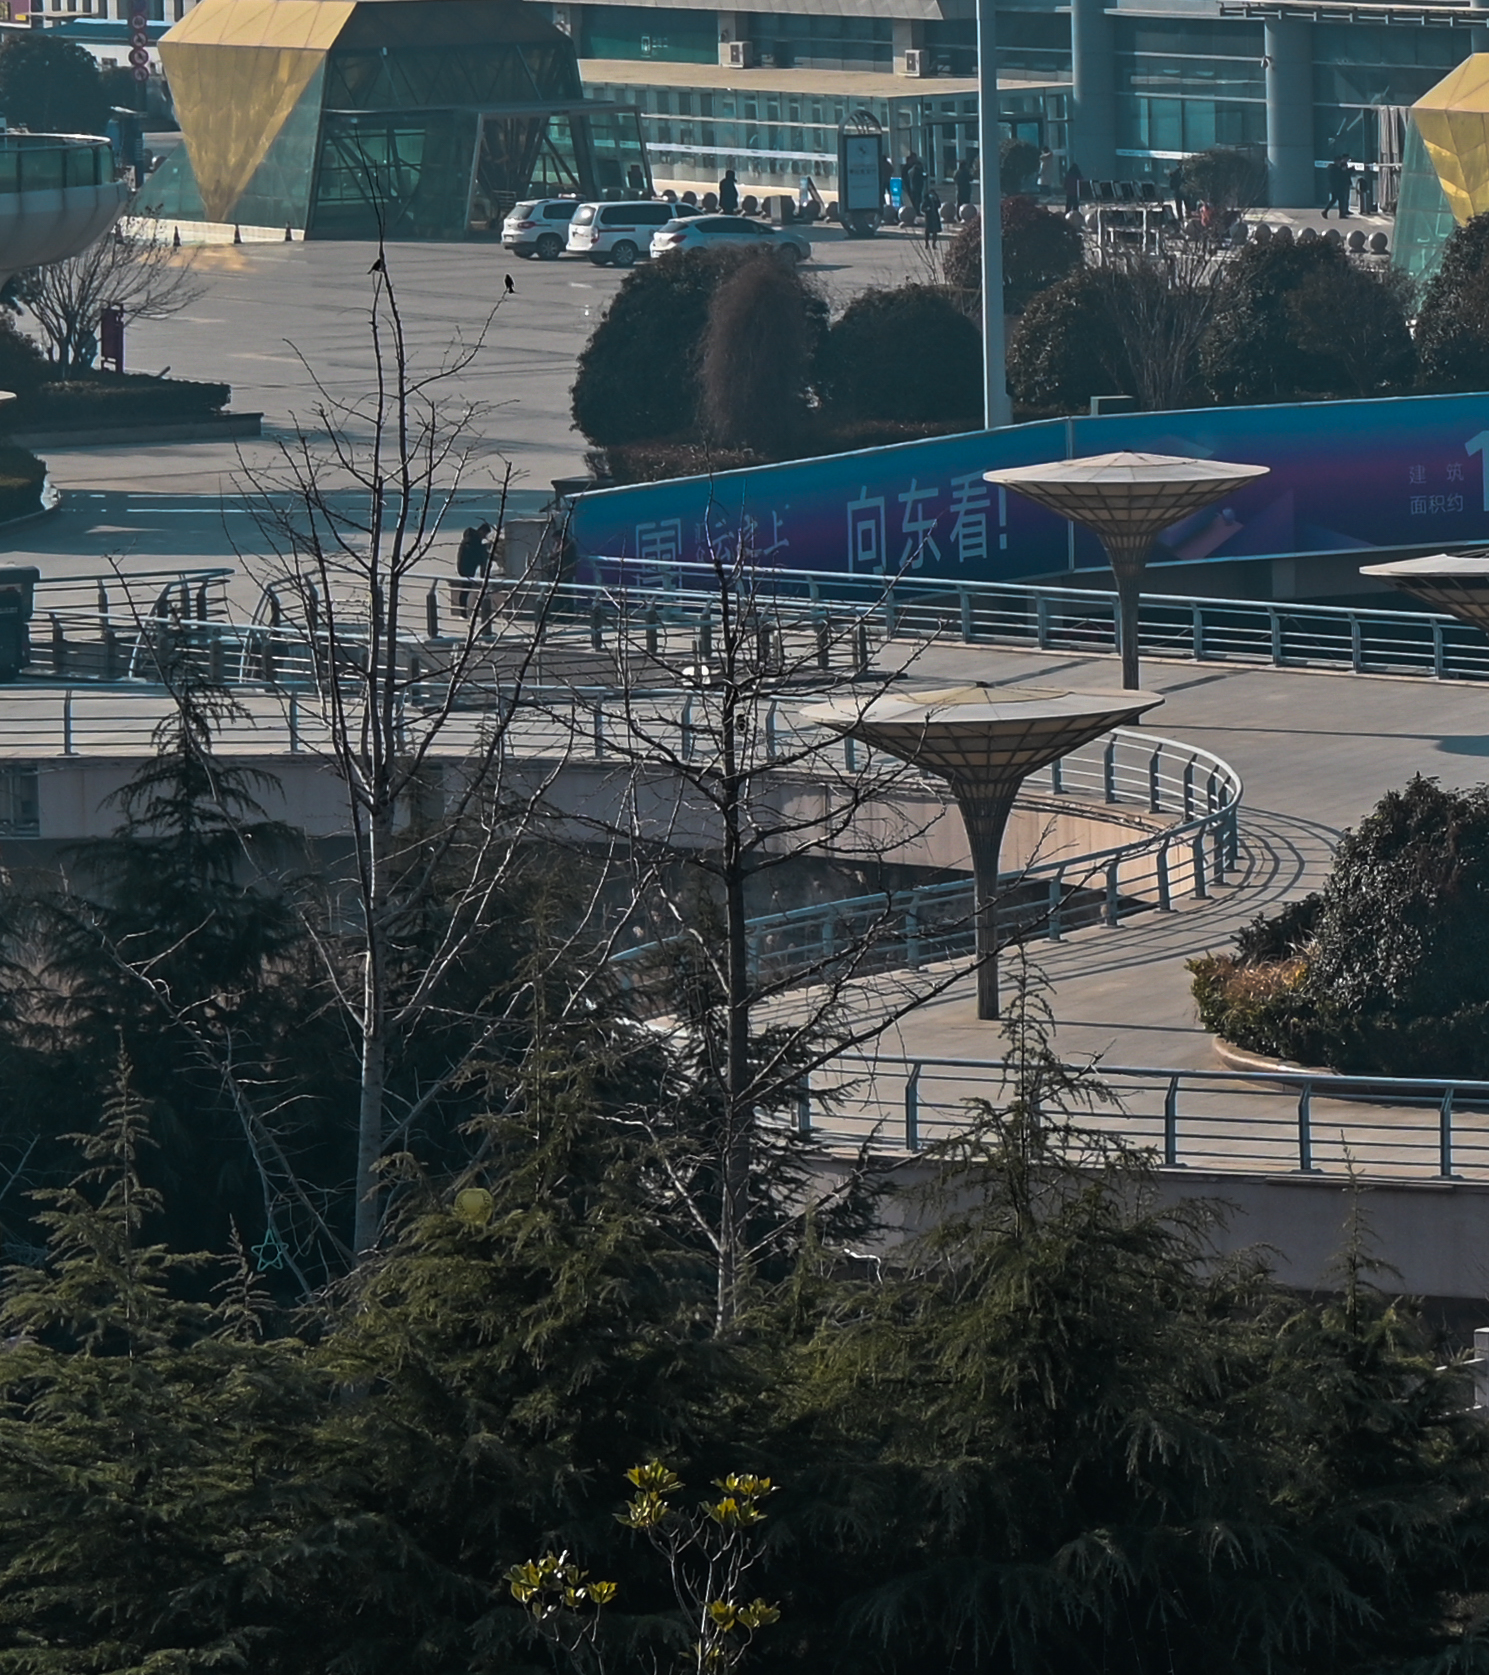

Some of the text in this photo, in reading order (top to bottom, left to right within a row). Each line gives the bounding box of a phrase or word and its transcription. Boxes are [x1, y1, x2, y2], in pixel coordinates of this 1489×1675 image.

[1408, 462, 1465, 485] 建筑
[1409, 492, 1465, 516] 面积约
